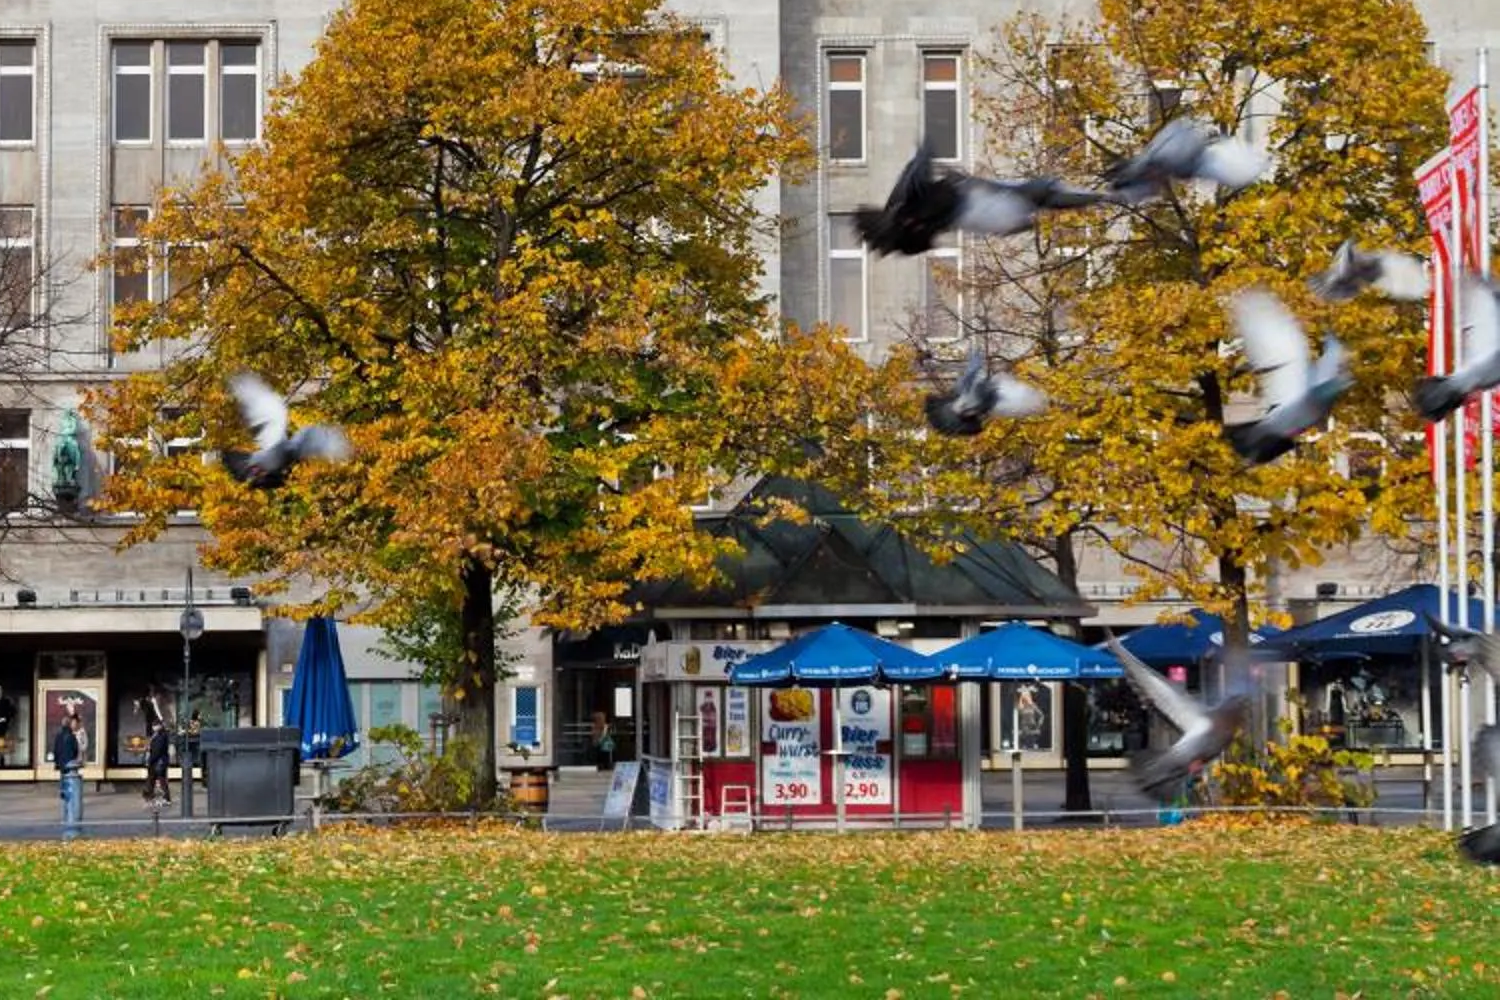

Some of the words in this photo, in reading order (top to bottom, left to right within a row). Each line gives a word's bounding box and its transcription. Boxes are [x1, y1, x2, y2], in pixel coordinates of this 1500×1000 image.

[768, 724, 812, 743] Curry-
[841, 725, 880, 744] Bier
[775, 783, 809, 800] 3,90
[845, 782, 880, 798] 2,90
